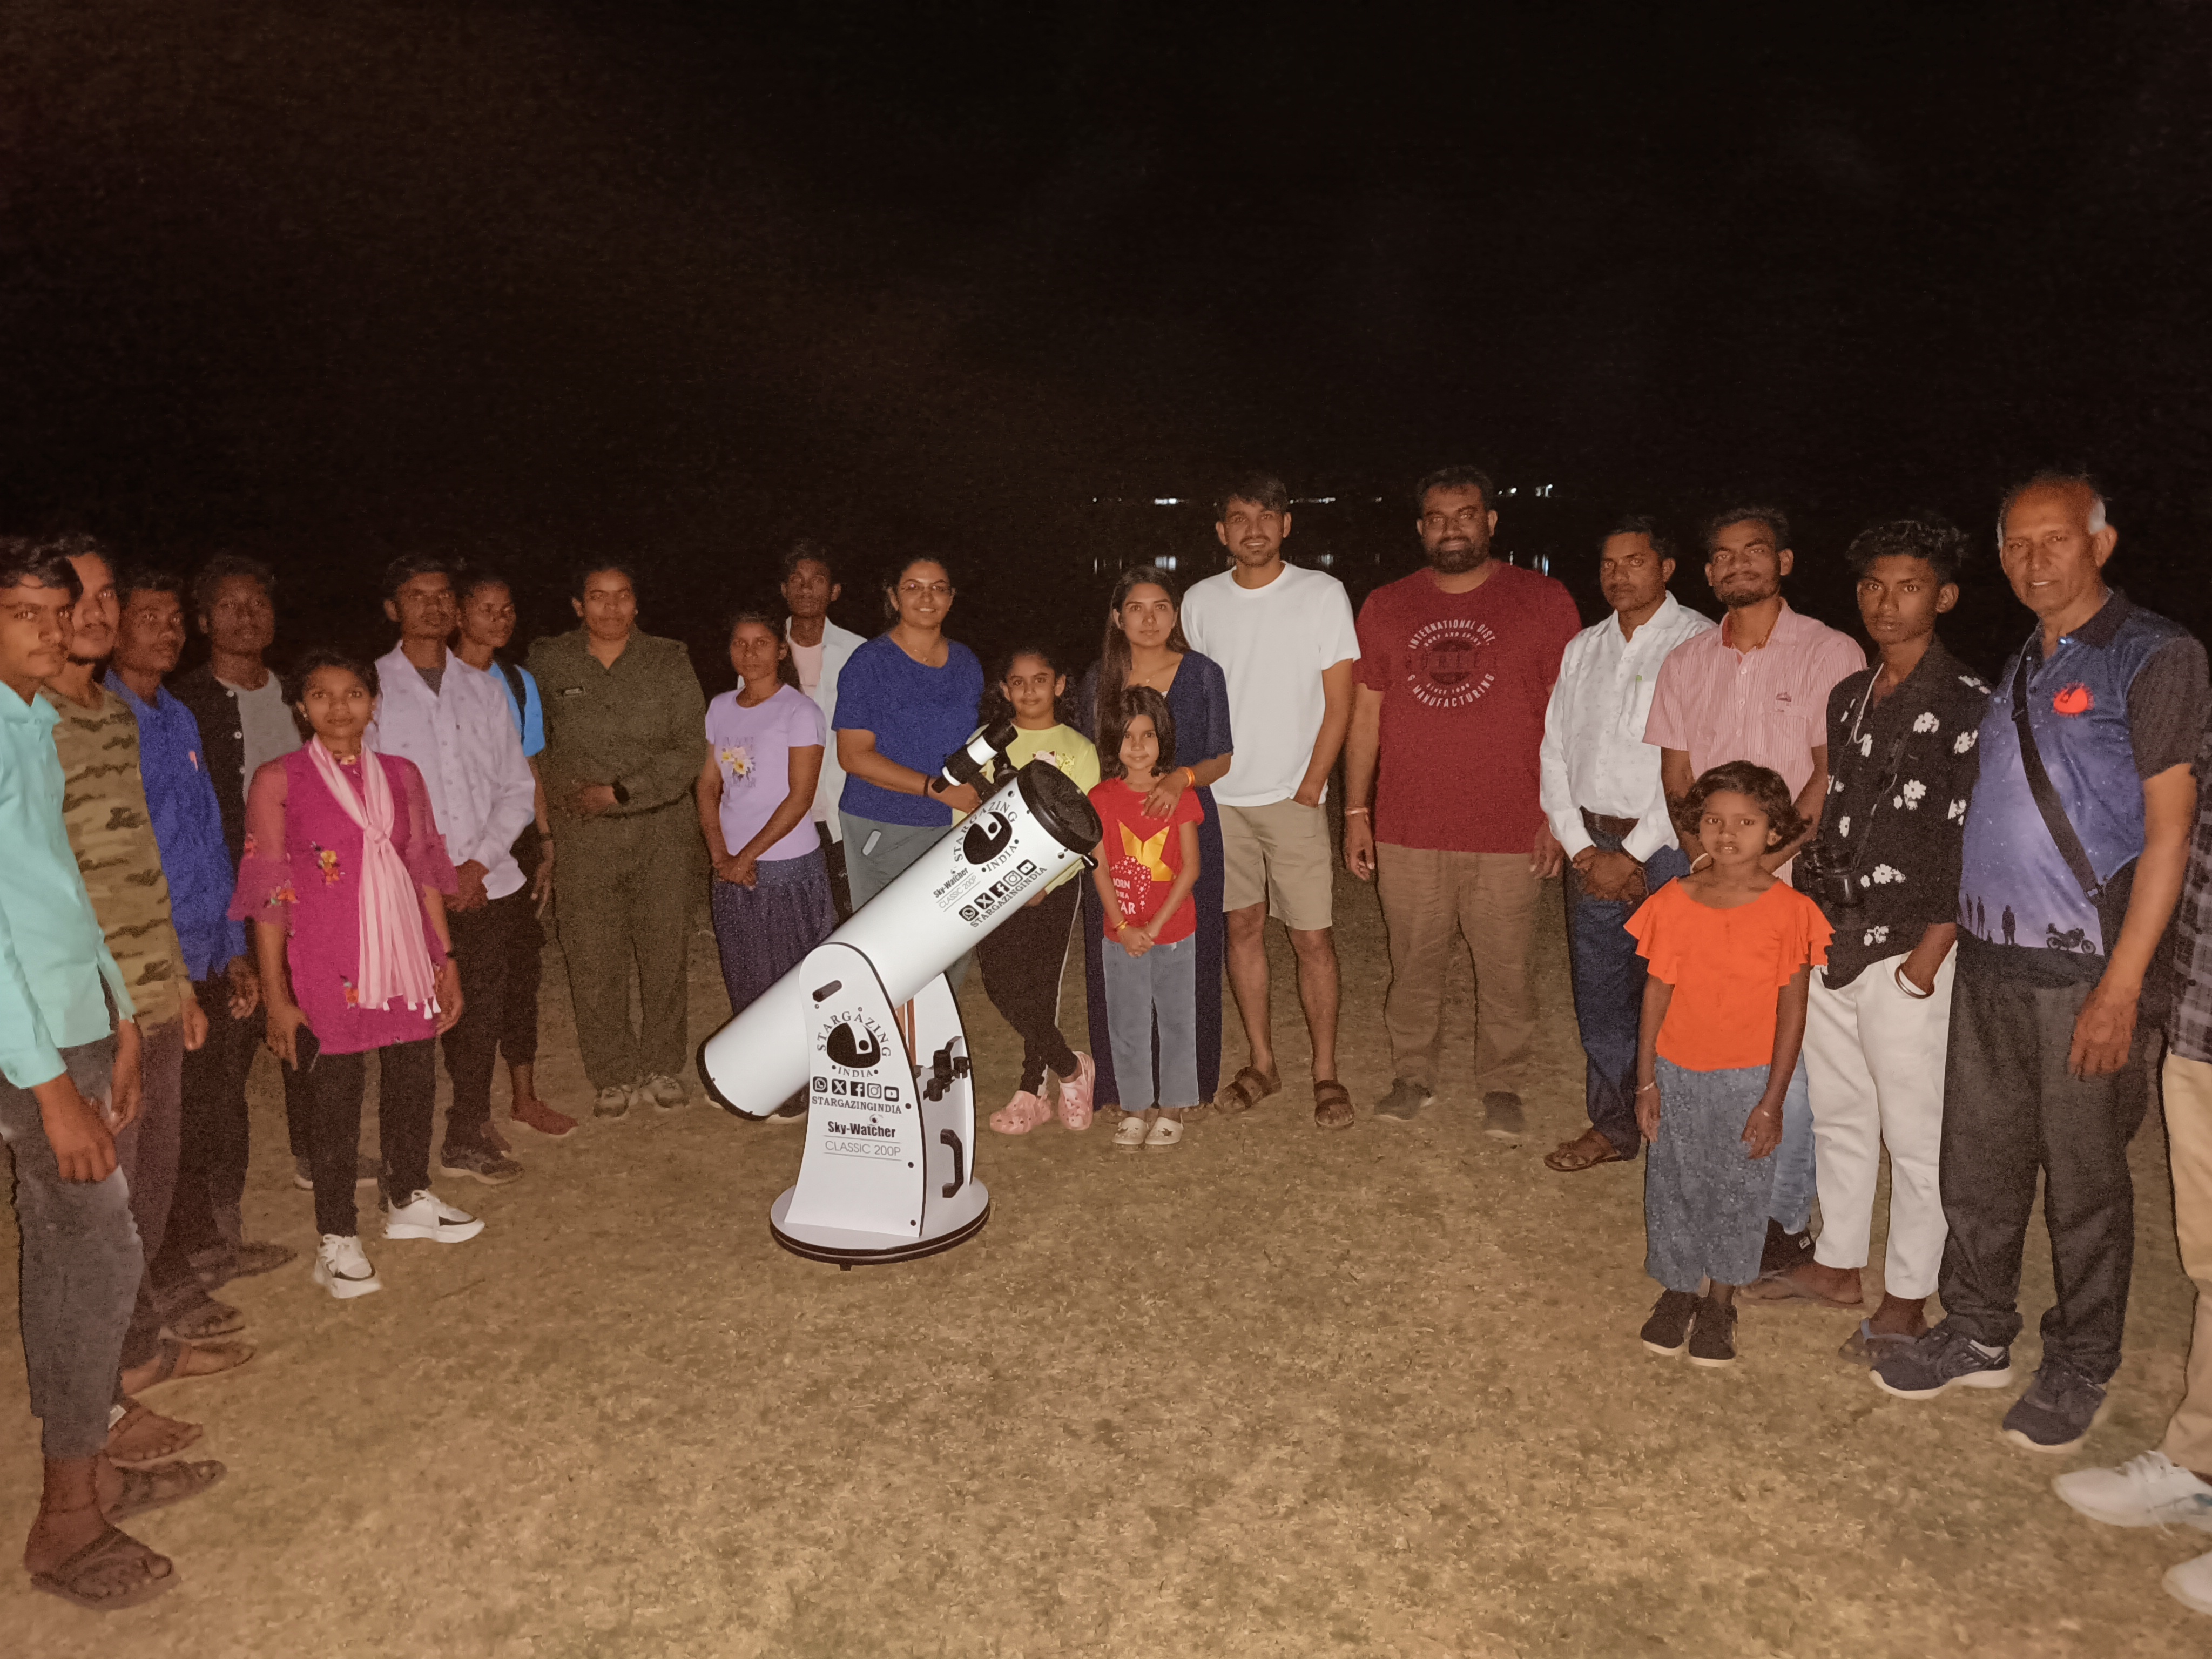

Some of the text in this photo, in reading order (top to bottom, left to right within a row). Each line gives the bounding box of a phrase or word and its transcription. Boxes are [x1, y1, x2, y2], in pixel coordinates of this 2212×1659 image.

[1407, 619, 1476, 649] INTERNATIONAL
[1412, 673, 1495, 708] MANUFACTURING
[954, 800, 1018, 862] STARGAZING
[986, 844, 1017, 872] INDIA
[933, 866, 969, 898] Sky-Watcher
[939, 875, 977, 909] CLASSIC 200P
[970, 866, 1048, 928] STARGAZINGINDIA
[817, 1011, 892, 1057] STARGAZING
[838, 1066, 874, 1078] INDIA
[812, 1096, 902, 1114] STARGAZINGINDIA
[828, 1121, 896, 1138] Sky-Watcher
[825, 1141, 901, 1157] CLASSIC 200P
